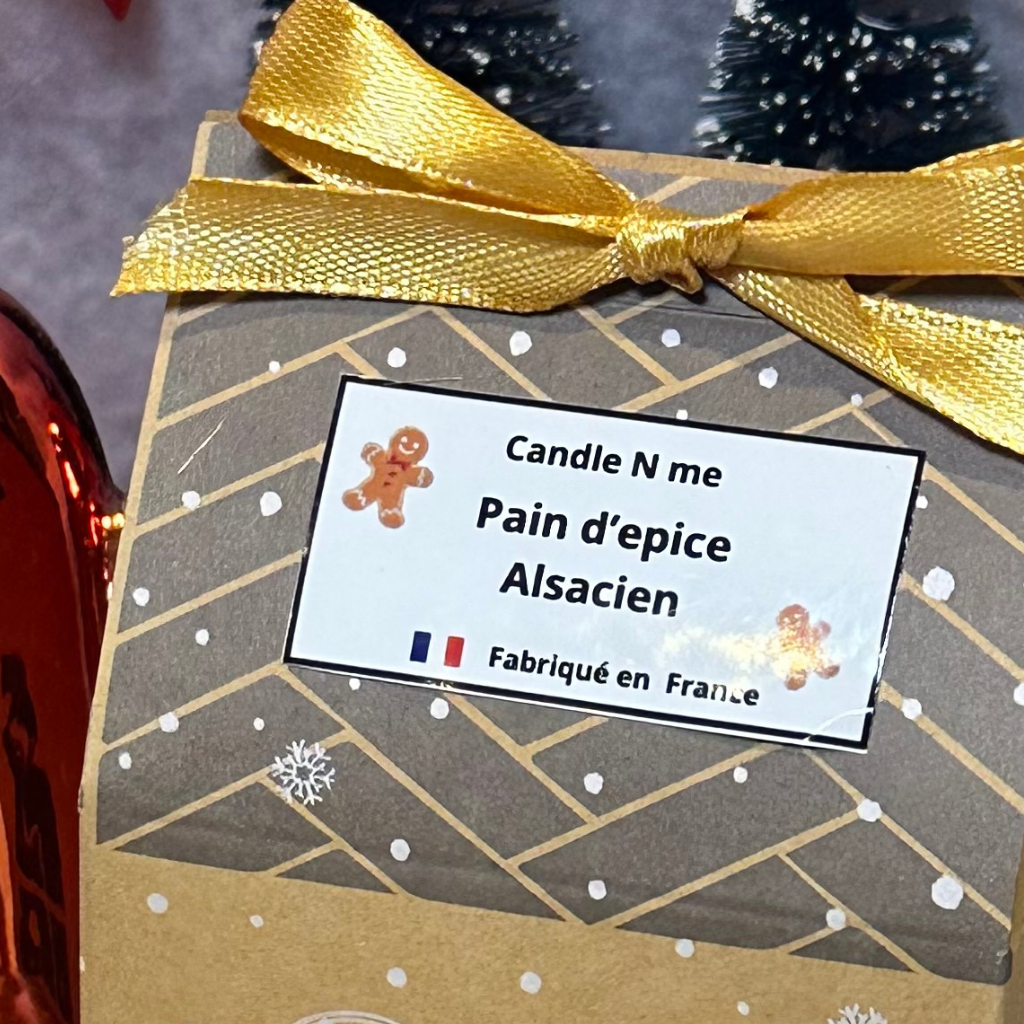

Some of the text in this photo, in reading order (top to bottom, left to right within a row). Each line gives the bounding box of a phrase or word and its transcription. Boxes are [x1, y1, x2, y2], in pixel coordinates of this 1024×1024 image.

[506, 435, 722, 488] Candle N me
[476, 496, 731, 563] Pain d’epice
[499, 562, 679, 617] Alsacien
[488, 646, 609, 686] Fabriqué
[616, 670, 650, 691] en
